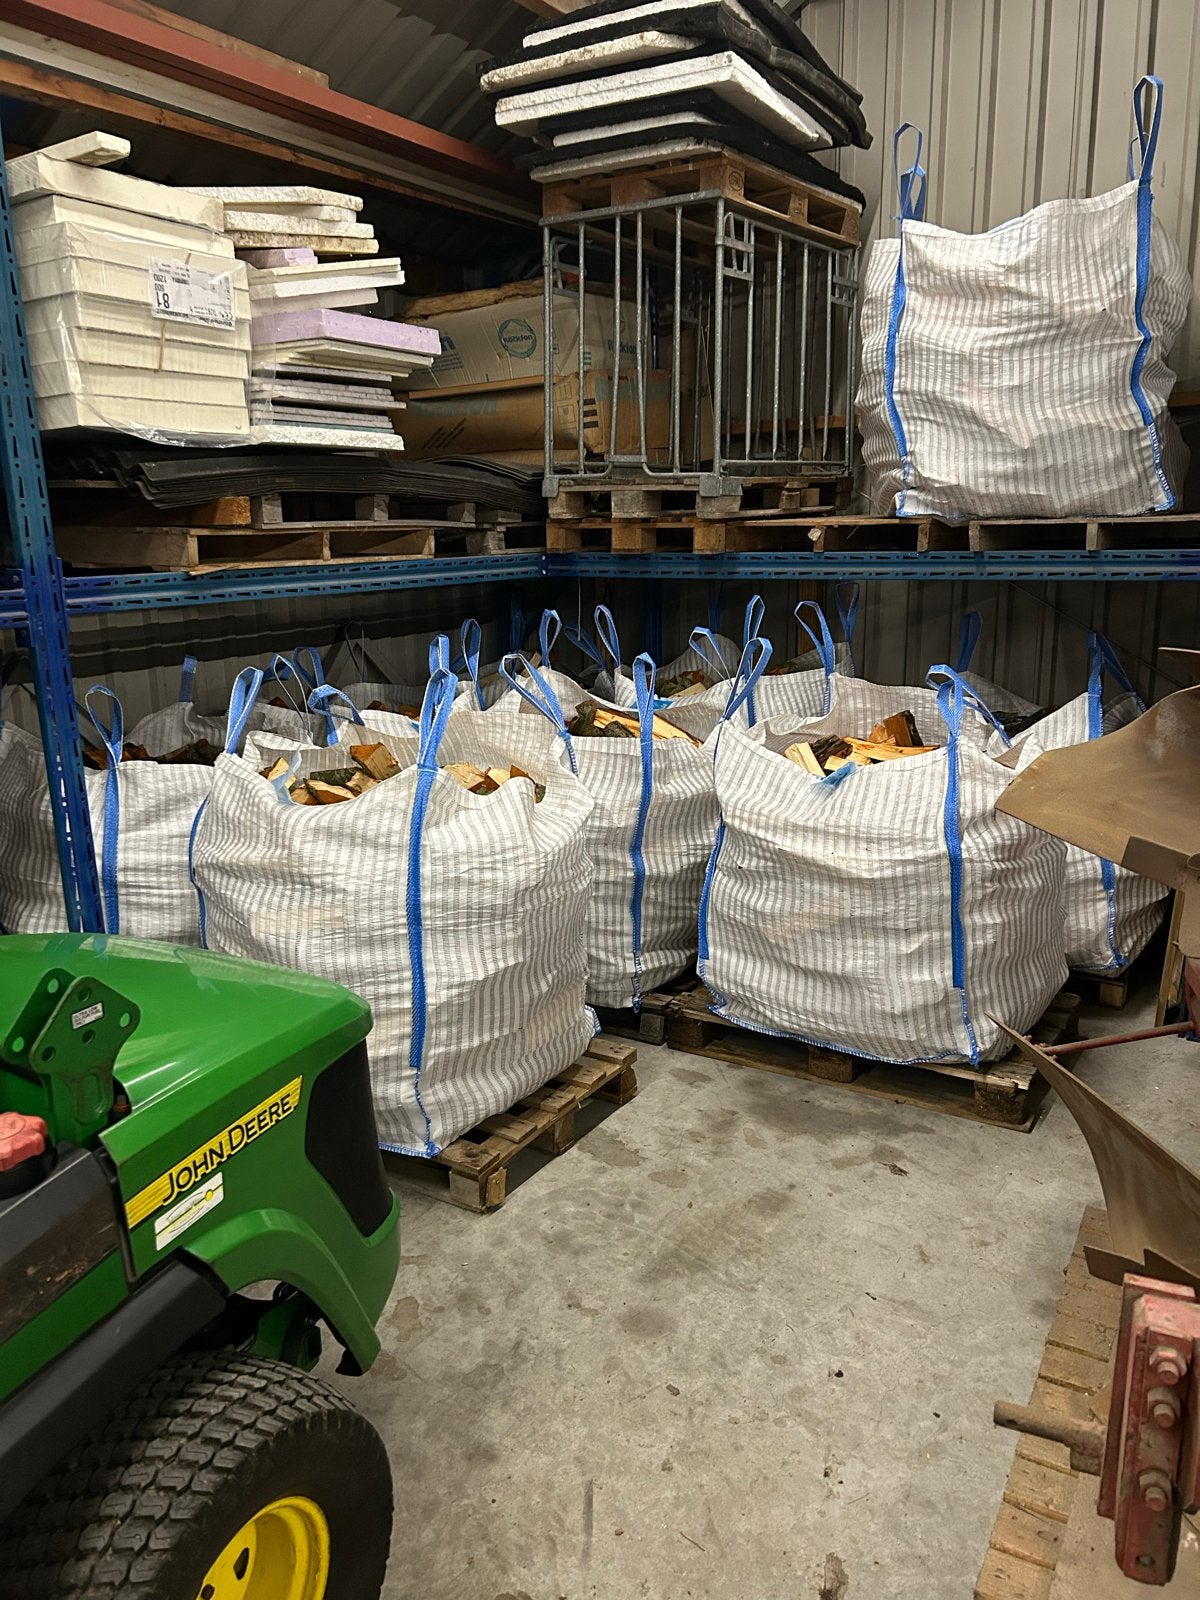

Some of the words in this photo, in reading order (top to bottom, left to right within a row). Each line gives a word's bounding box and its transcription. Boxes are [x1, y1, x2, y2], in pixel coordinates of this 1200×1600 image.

[156, 291, 170, 309] 81
[162, 1140, 226, 1204] JOHN
[228, 1093, 292, 1151] DEERE
